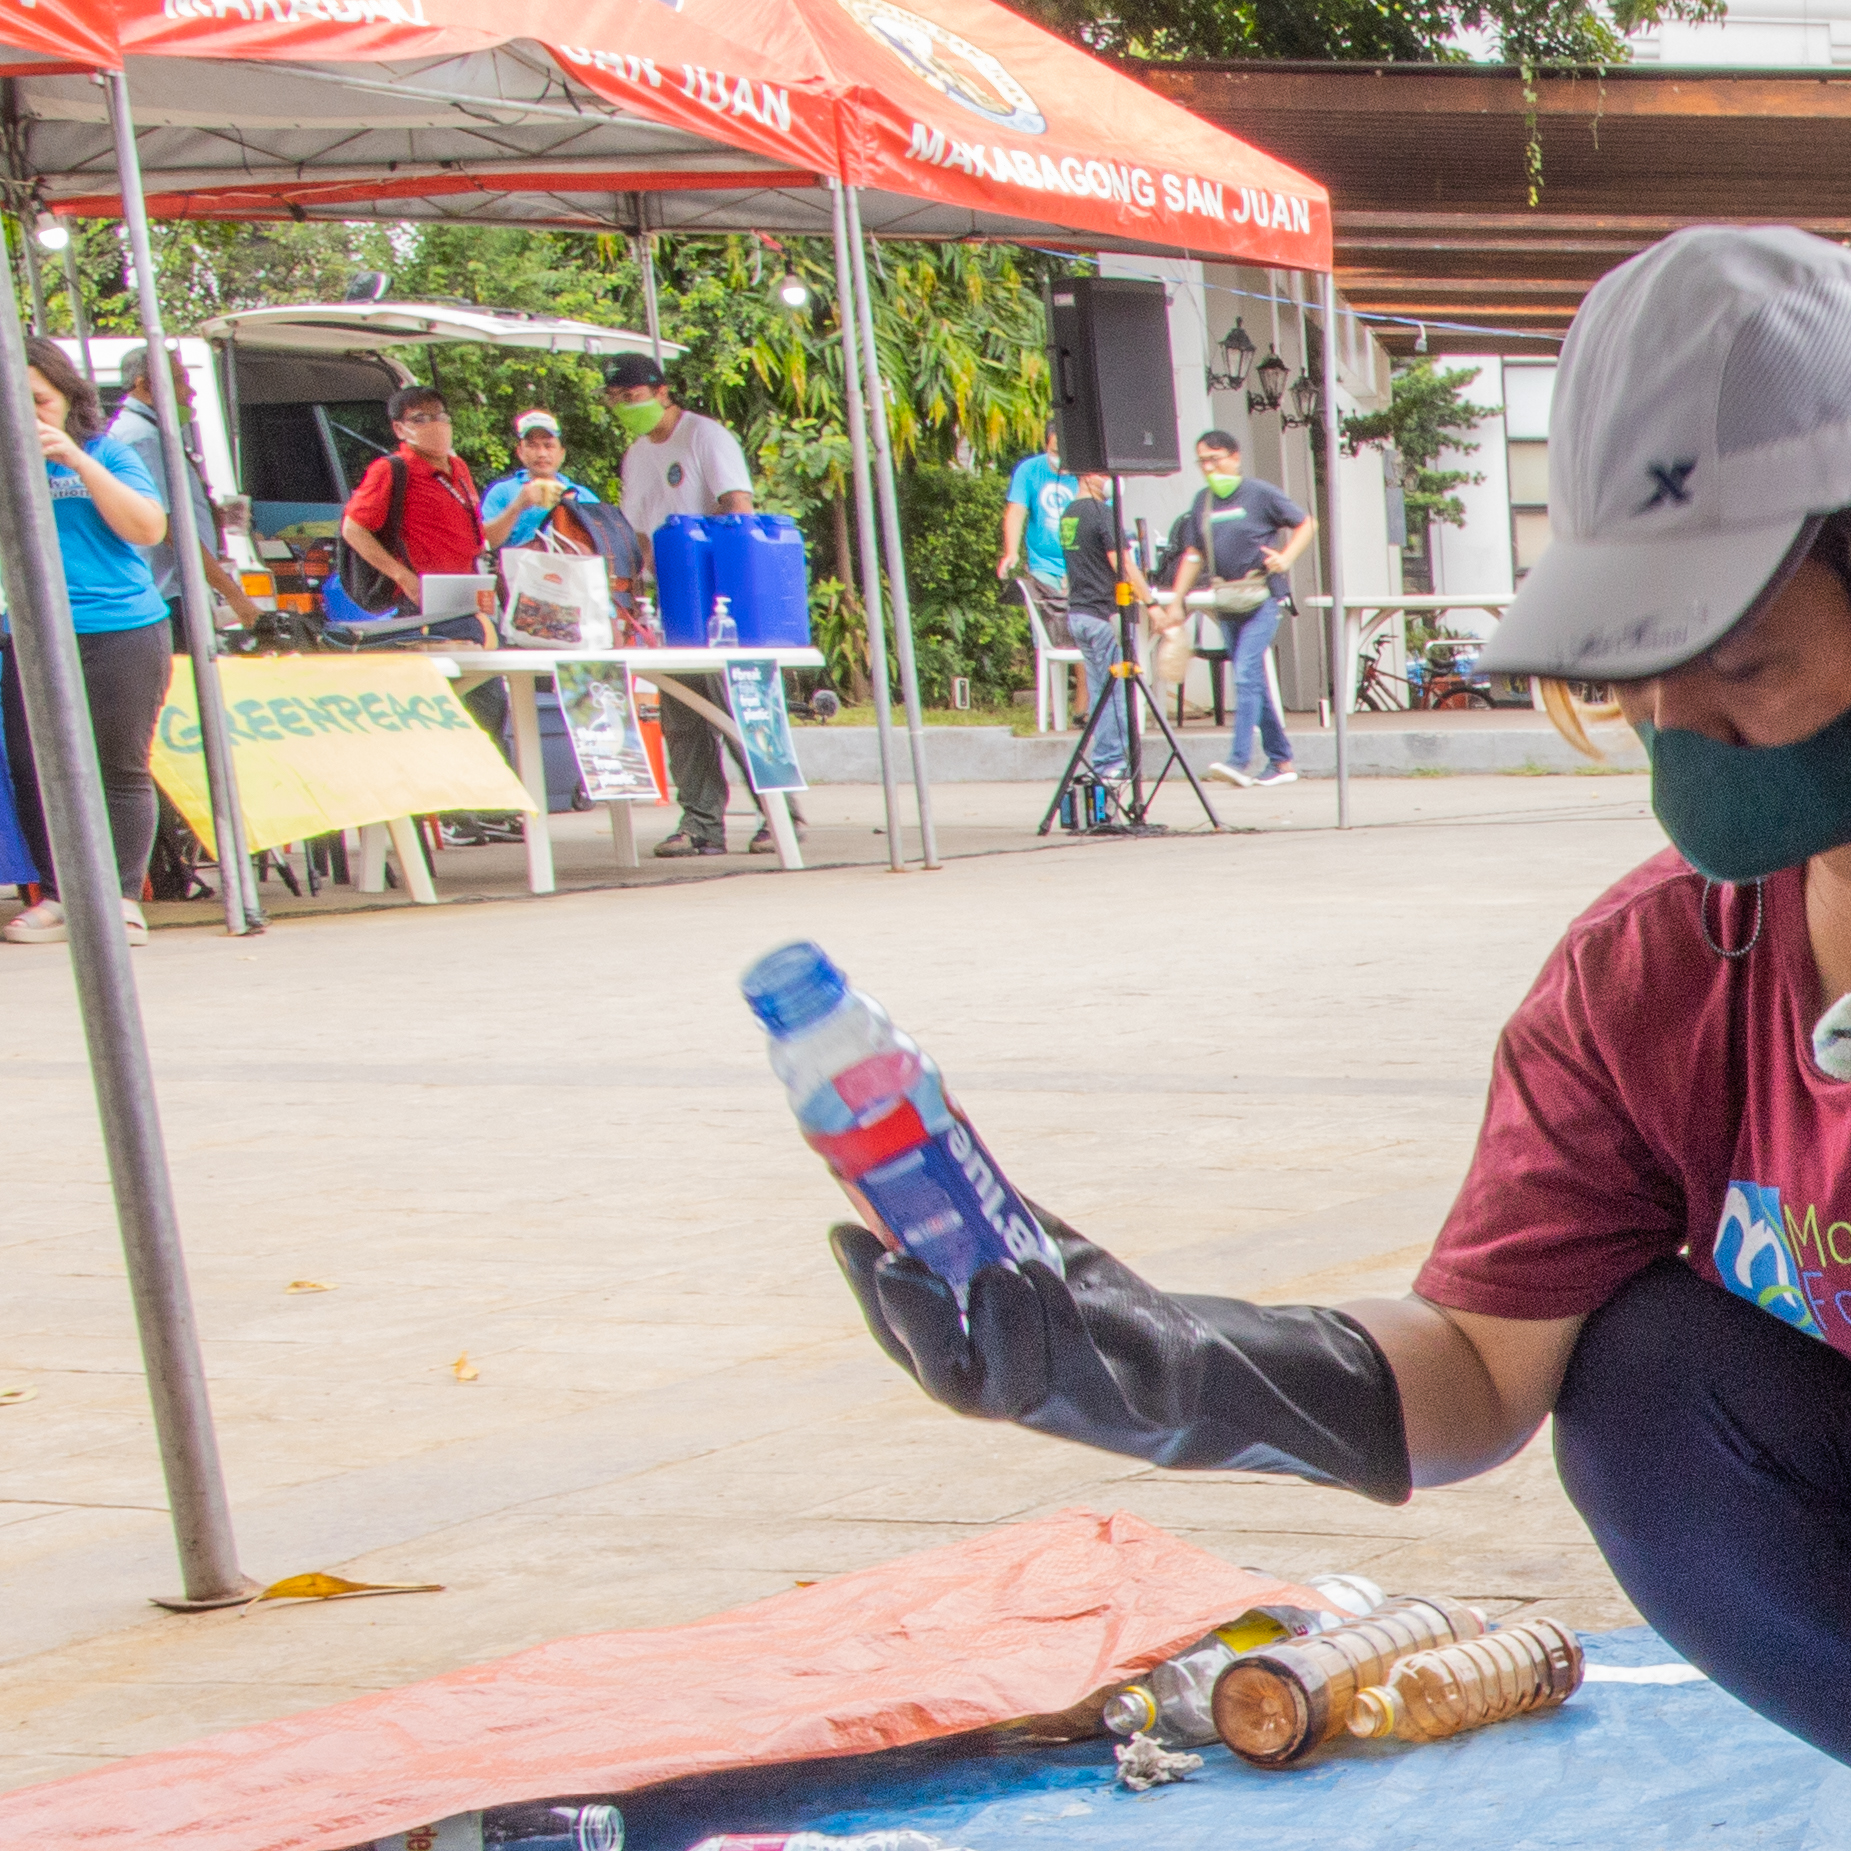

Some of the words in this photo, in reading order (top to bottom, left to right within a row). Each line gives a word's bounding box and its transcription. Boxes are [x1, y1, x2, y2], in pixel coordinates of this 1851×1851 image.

[680, 64, 793, 132] JUAN
[905, 122, 1156, 207] MAKABAGONG
[1163, 174, 1226, 221] SAN
[1232, 186, 1311, 236] JUAN
[160, 692, 472, 754] GEENPEACE
